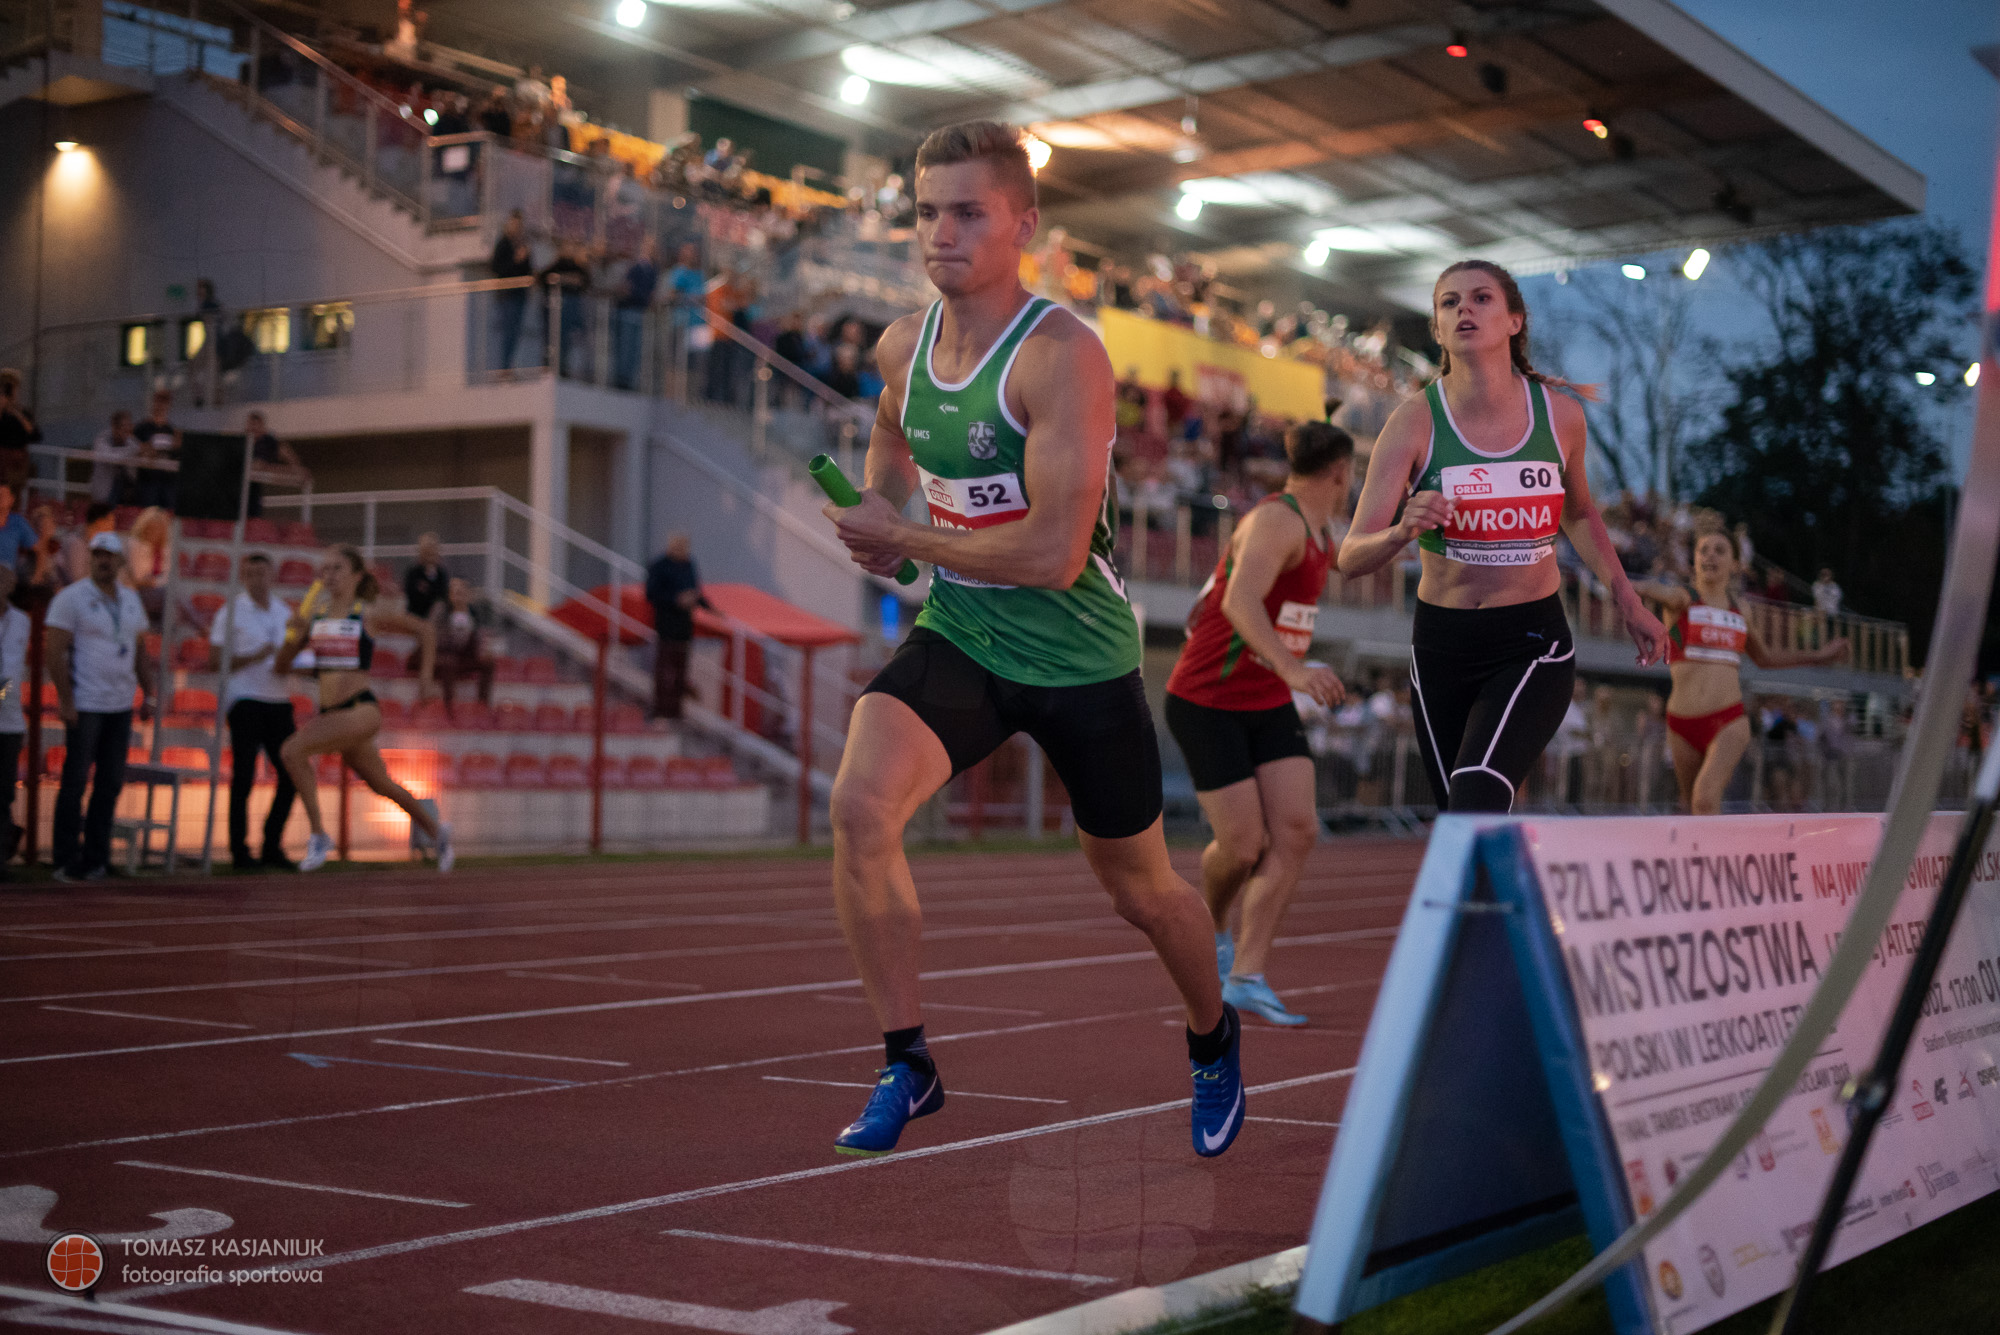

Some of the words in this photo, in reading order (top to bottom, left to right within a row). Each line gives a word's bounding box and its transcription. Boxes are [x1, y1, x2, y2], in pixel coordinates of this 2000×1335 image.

[913, 429, 930, 440] UMCS
[1455, 485, 1491, 494] ORLEN
[1519, 468, 1552, 489] 60
[967, 483, 1013, 508] 52
[1453, 505, 1553, 532] WRONA
[1452, 550, 1532, 564] INOWROCŁAW
[1631, 842, 1804, 916] DRUŻYNOWE
[1566, 920, 1821, 1019] MISTRZOSTWA
[1597, 1028, 1671, 1081] POLSKI
